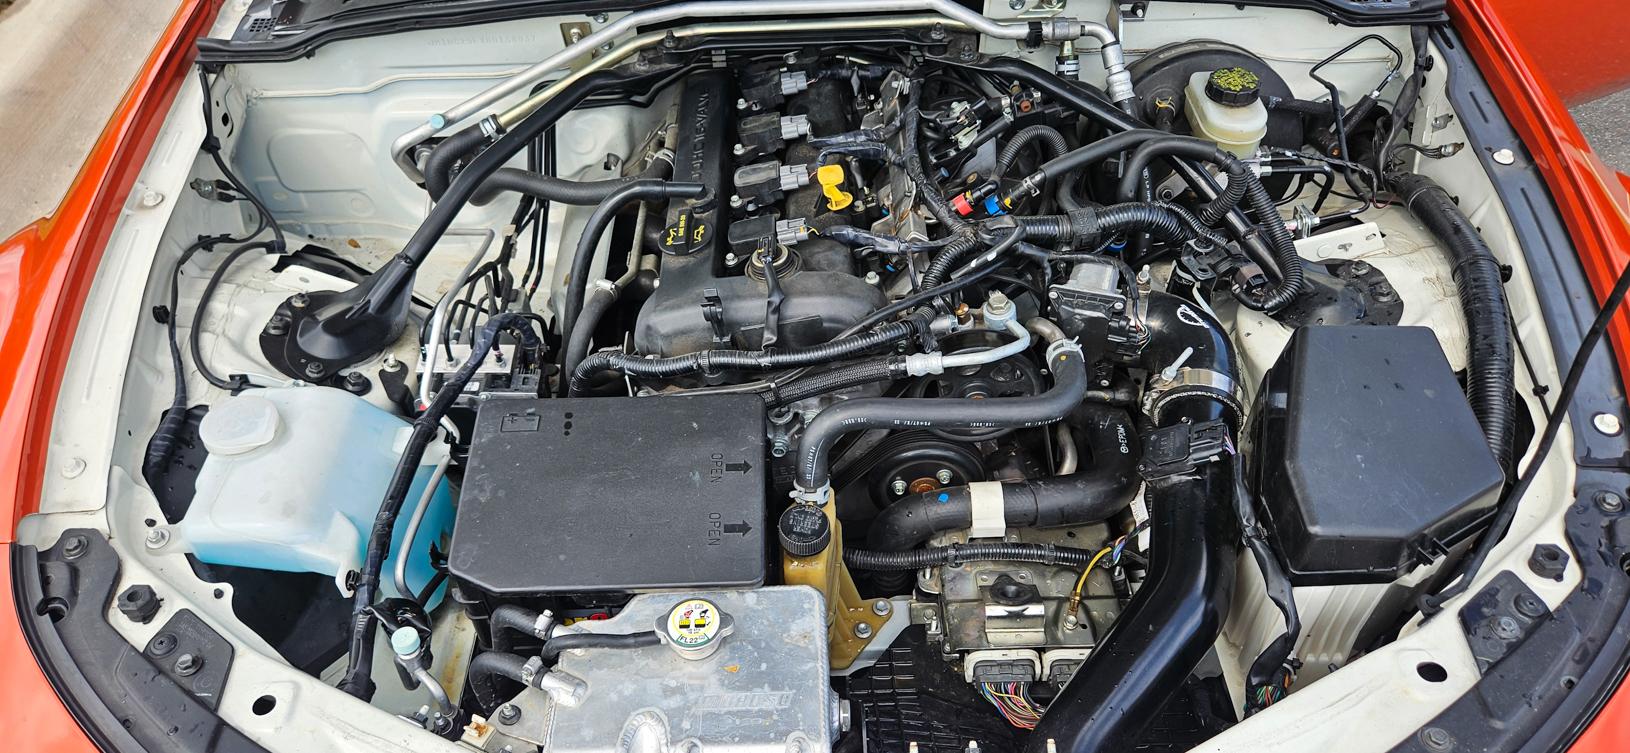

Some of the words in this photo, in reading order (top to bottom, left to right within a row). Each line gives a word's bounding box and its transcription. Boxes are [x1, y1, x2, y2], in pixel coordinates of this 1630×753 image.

[710, 452, 724, 483] OPEN
[708, 512, 722, 546] OPEN
[680, 635, 698, 644] FL22
